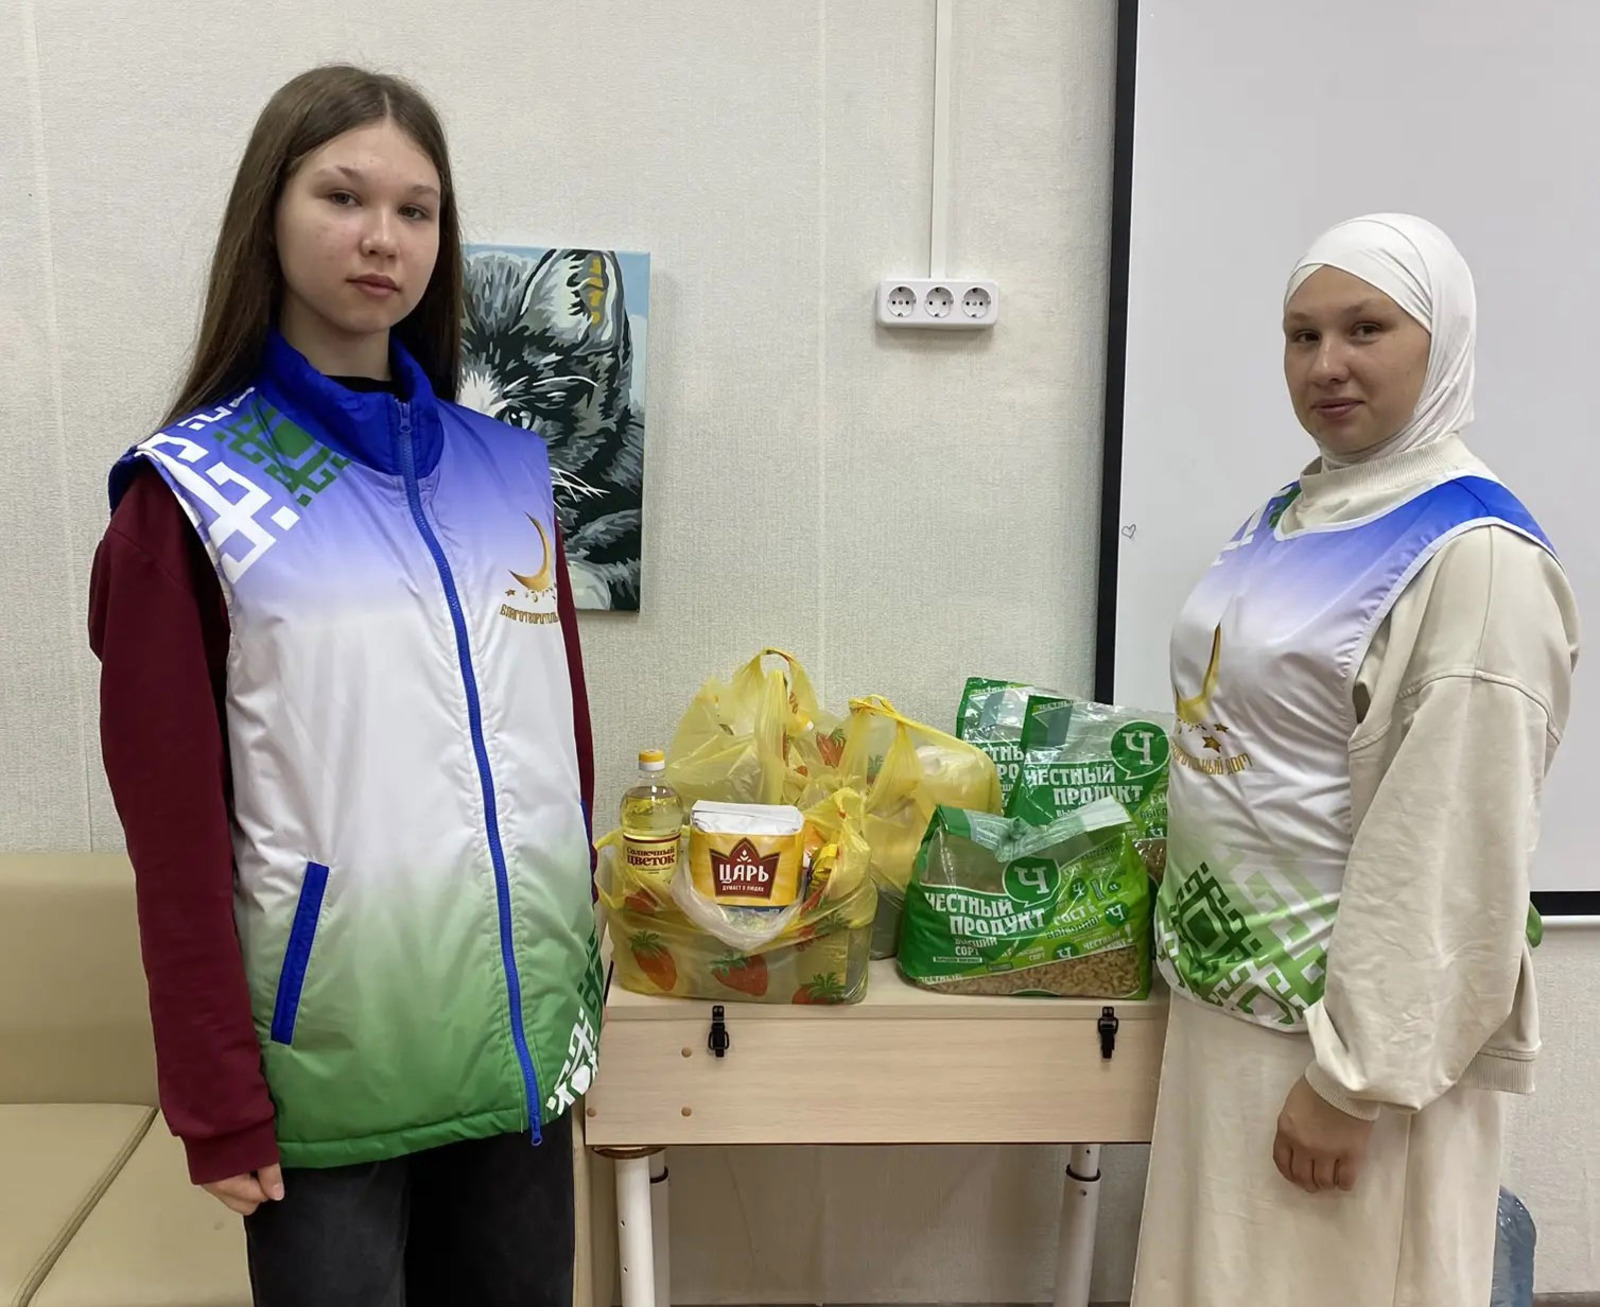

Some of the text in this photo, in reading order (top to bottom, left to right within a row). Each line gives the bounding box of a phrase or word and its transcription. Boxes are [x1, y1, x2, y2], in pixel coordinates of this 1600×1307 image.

[1122, 731, 1155, 766] Ч
[1023, 764, 1116, 787] ЧЕСТНЫЙ
[719, 864, 769, 884] ЦАРЬ
[1014, 866, 1050, 895] Ч
[924, 891, 1014, 918] ЧЕСТНЫЙ
[949, 907, 1046, 937] ПРОДУКТ
[954, 945, 980, 957] СОРТ
